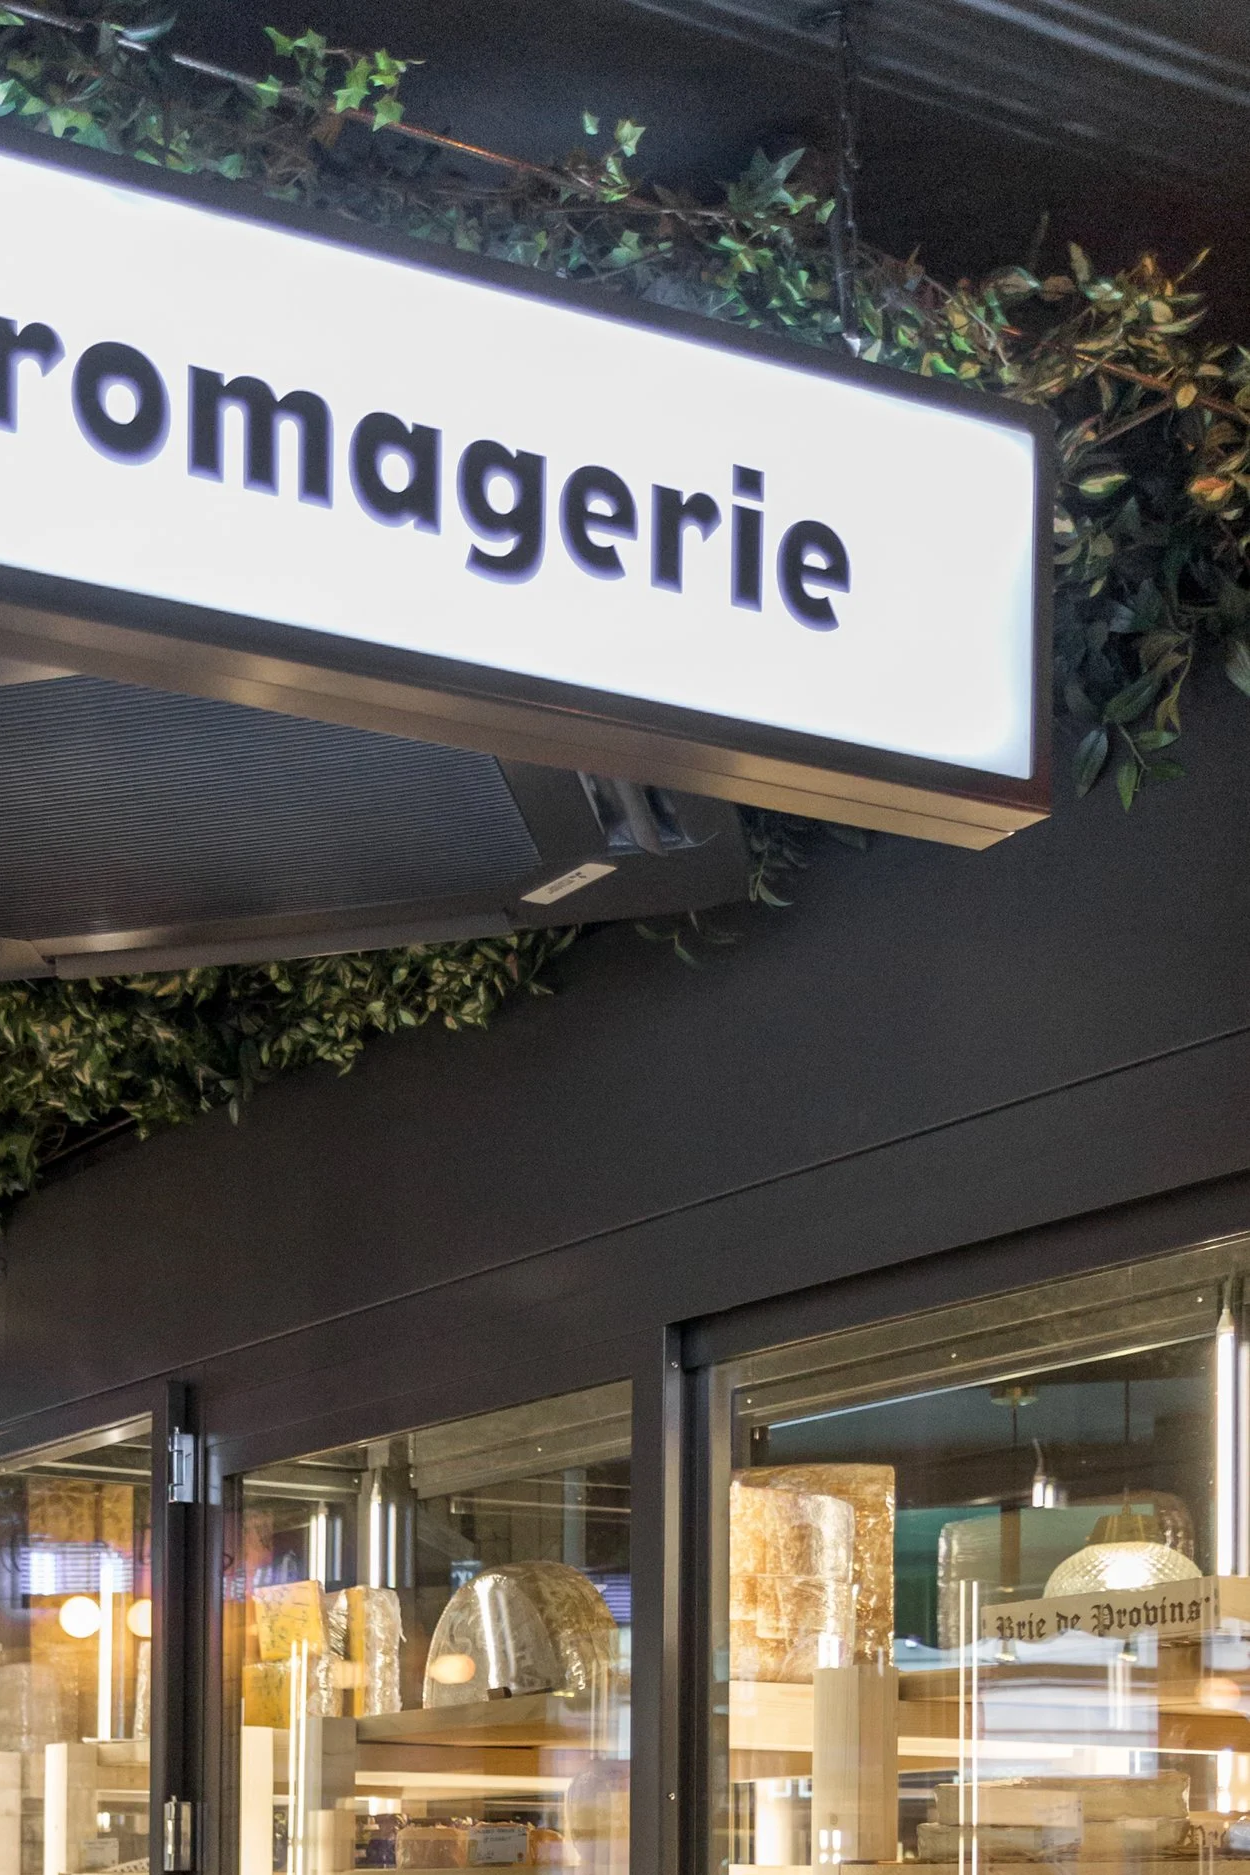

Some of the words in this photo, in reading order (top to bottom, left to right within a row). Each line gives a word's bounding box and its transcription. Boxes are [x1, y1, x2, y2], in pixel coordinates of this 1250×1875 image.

[996, 1612, 1046, 1640] Brie
[1056, 1611, 1081, 1635] de
[1091, 1597, 1202, 1638] Provins
